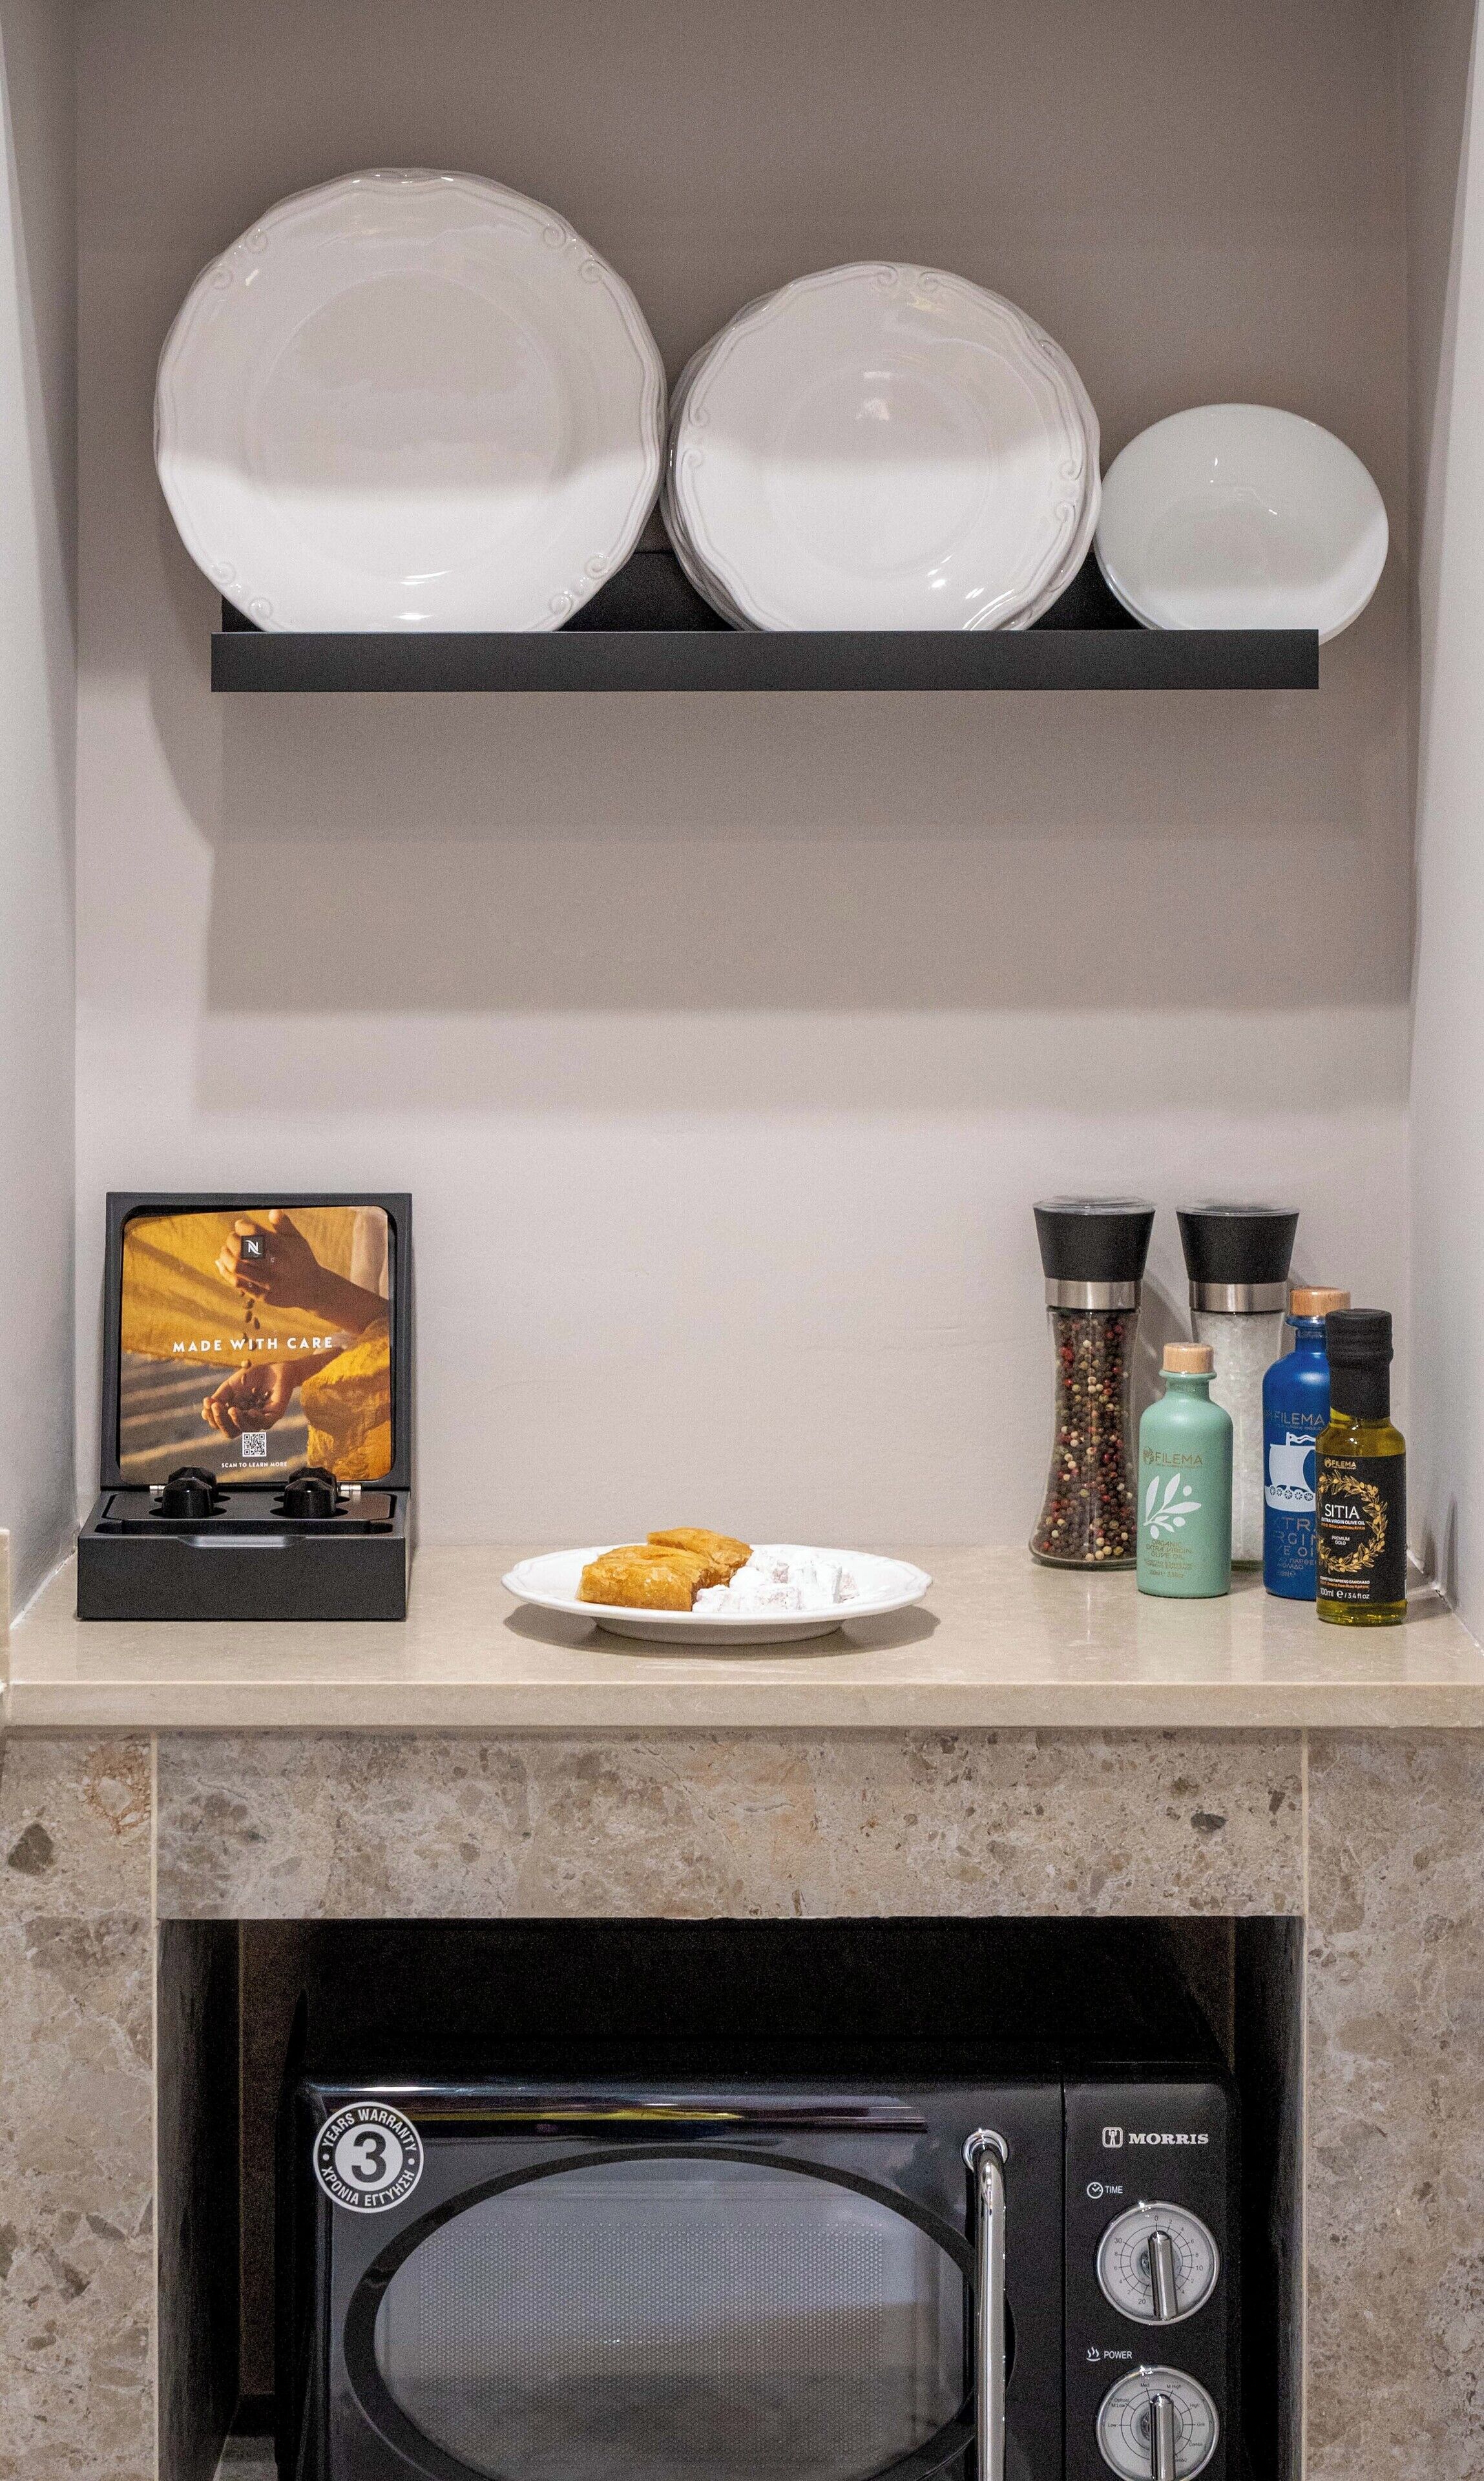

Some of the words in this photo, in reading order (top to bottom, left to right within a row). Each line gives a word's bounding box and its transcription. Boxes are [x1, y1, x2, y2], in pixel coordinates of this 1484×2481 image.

[172, 1339, 222, 1353] MADE
[230, 1338, 278, 1350] WITH
[287, 1337, 333, 1349] CARE
[1275, 1410, 1324, 1426] FILEMA
[1155, 1452, 1203, 1465] FILEMA
[1325, 1503, 1360, 1519] SITIA
[322, 2113, 355, 2148] YEARS
[358, 2108, 417, 2151] WARRANTY
[1129, 2133, 1209, 2145] MORRIS
[351, 2131, 386, 2183] 3
[322, 2166, 359, 2205] ΧΡΟΝΙΑ
[364, 2170, 415, 2206] ΕΓΓΥΗΣΗ
[1105, 2186, 1123, 2194] TIME
[1104, 2350, 1133, 2359] POWER
